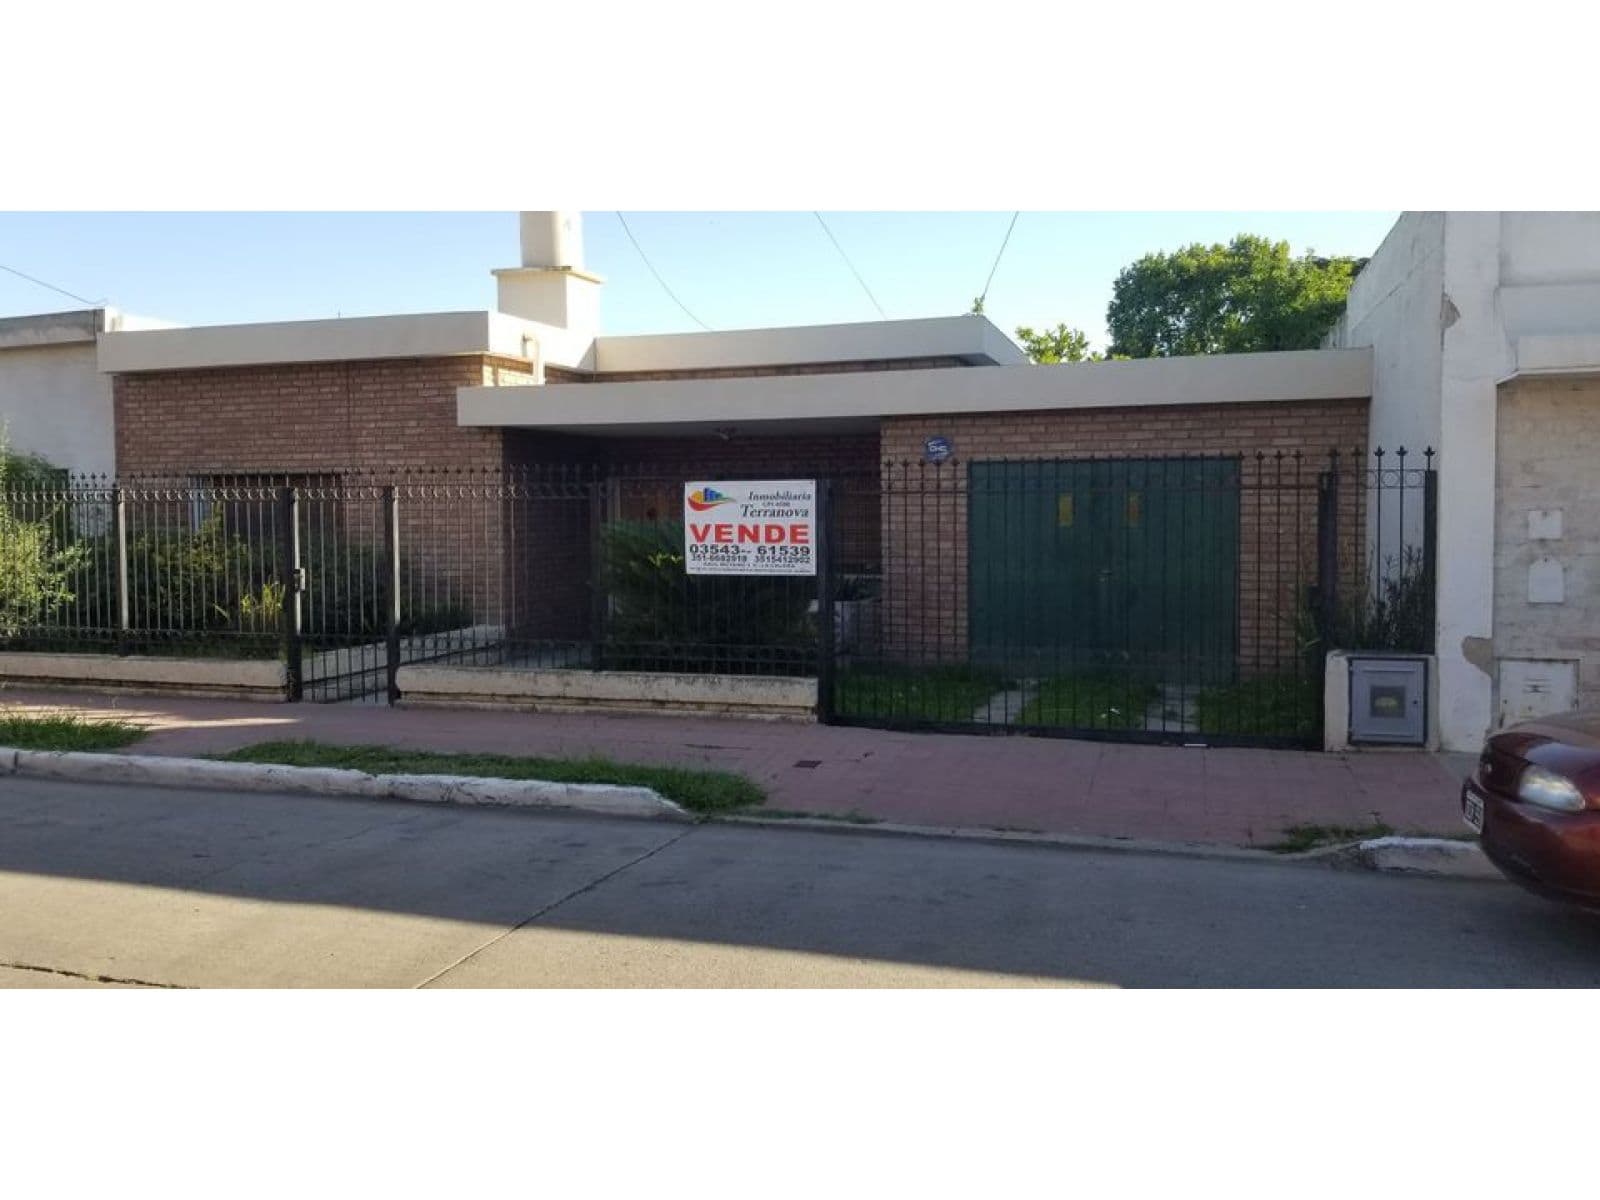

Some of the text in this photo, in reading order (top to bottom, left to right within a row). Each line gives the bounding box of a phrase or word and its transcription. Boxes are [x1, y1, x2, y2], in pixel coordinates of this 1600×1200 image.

[749, 491, 812, 501] Inmobiliaria
[740, 503, 809, 517] Terranova
[690, 523, 810, 544] VENDE
[757, 545, 811, 556] 61539
